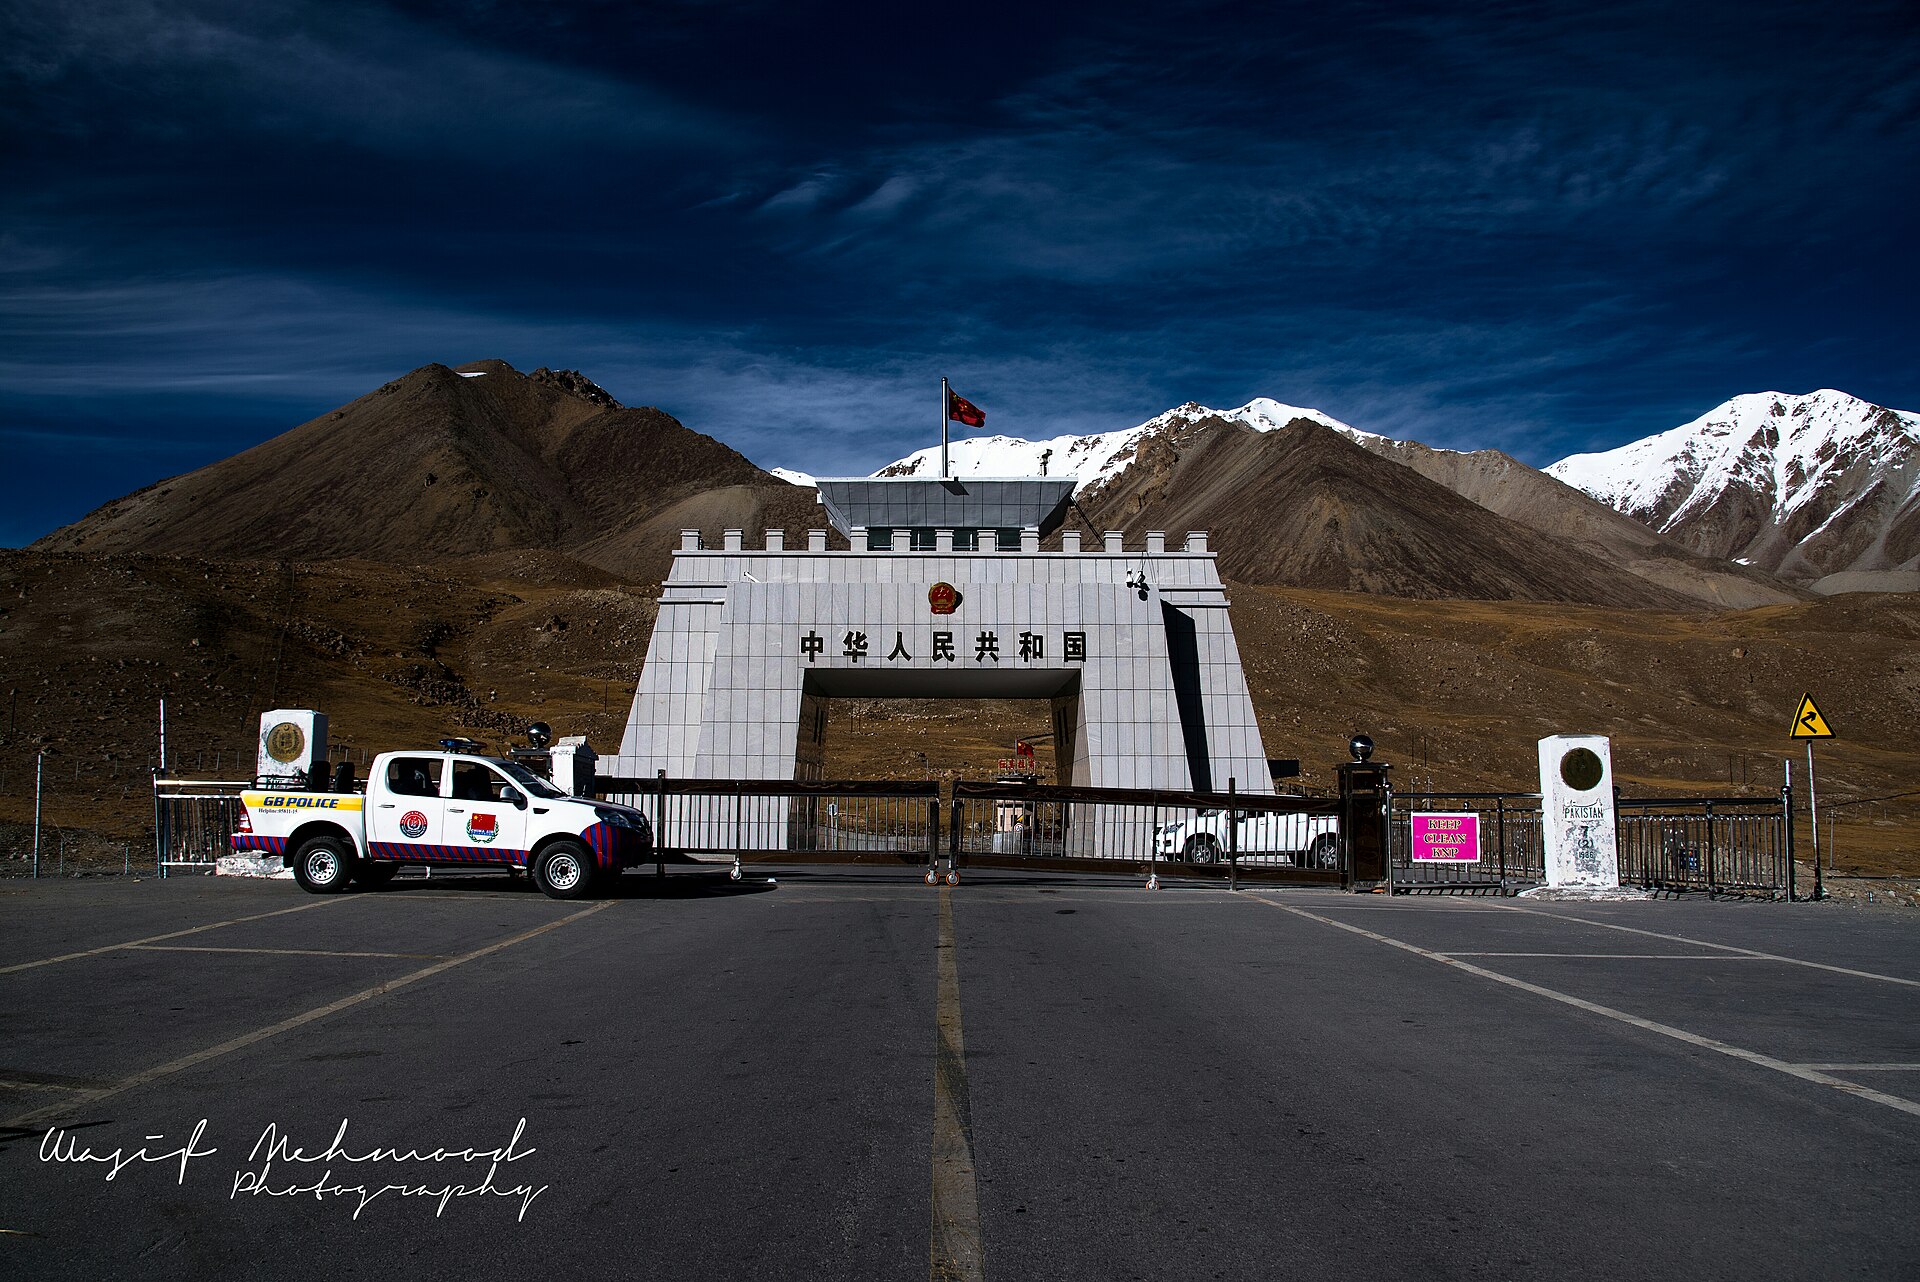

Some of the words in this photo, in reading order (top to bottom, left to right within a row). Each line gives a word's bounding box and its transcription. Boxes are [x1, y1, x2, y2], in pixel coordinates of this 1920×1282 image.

[801, 630, 1087, 662] 中华人民共和国
[263, 796, 285, 807] GB
[286, 797, 339, 809] POLICE
[1564, 806, 1604, 819] PAKISTAN
[1428, 819, 1462, 830] KEEP
[1581, 825, 1589, 838] 7
[1423, 833, 1467, 844] CLEAN
[1431, 847, 1459, 858] KNP
